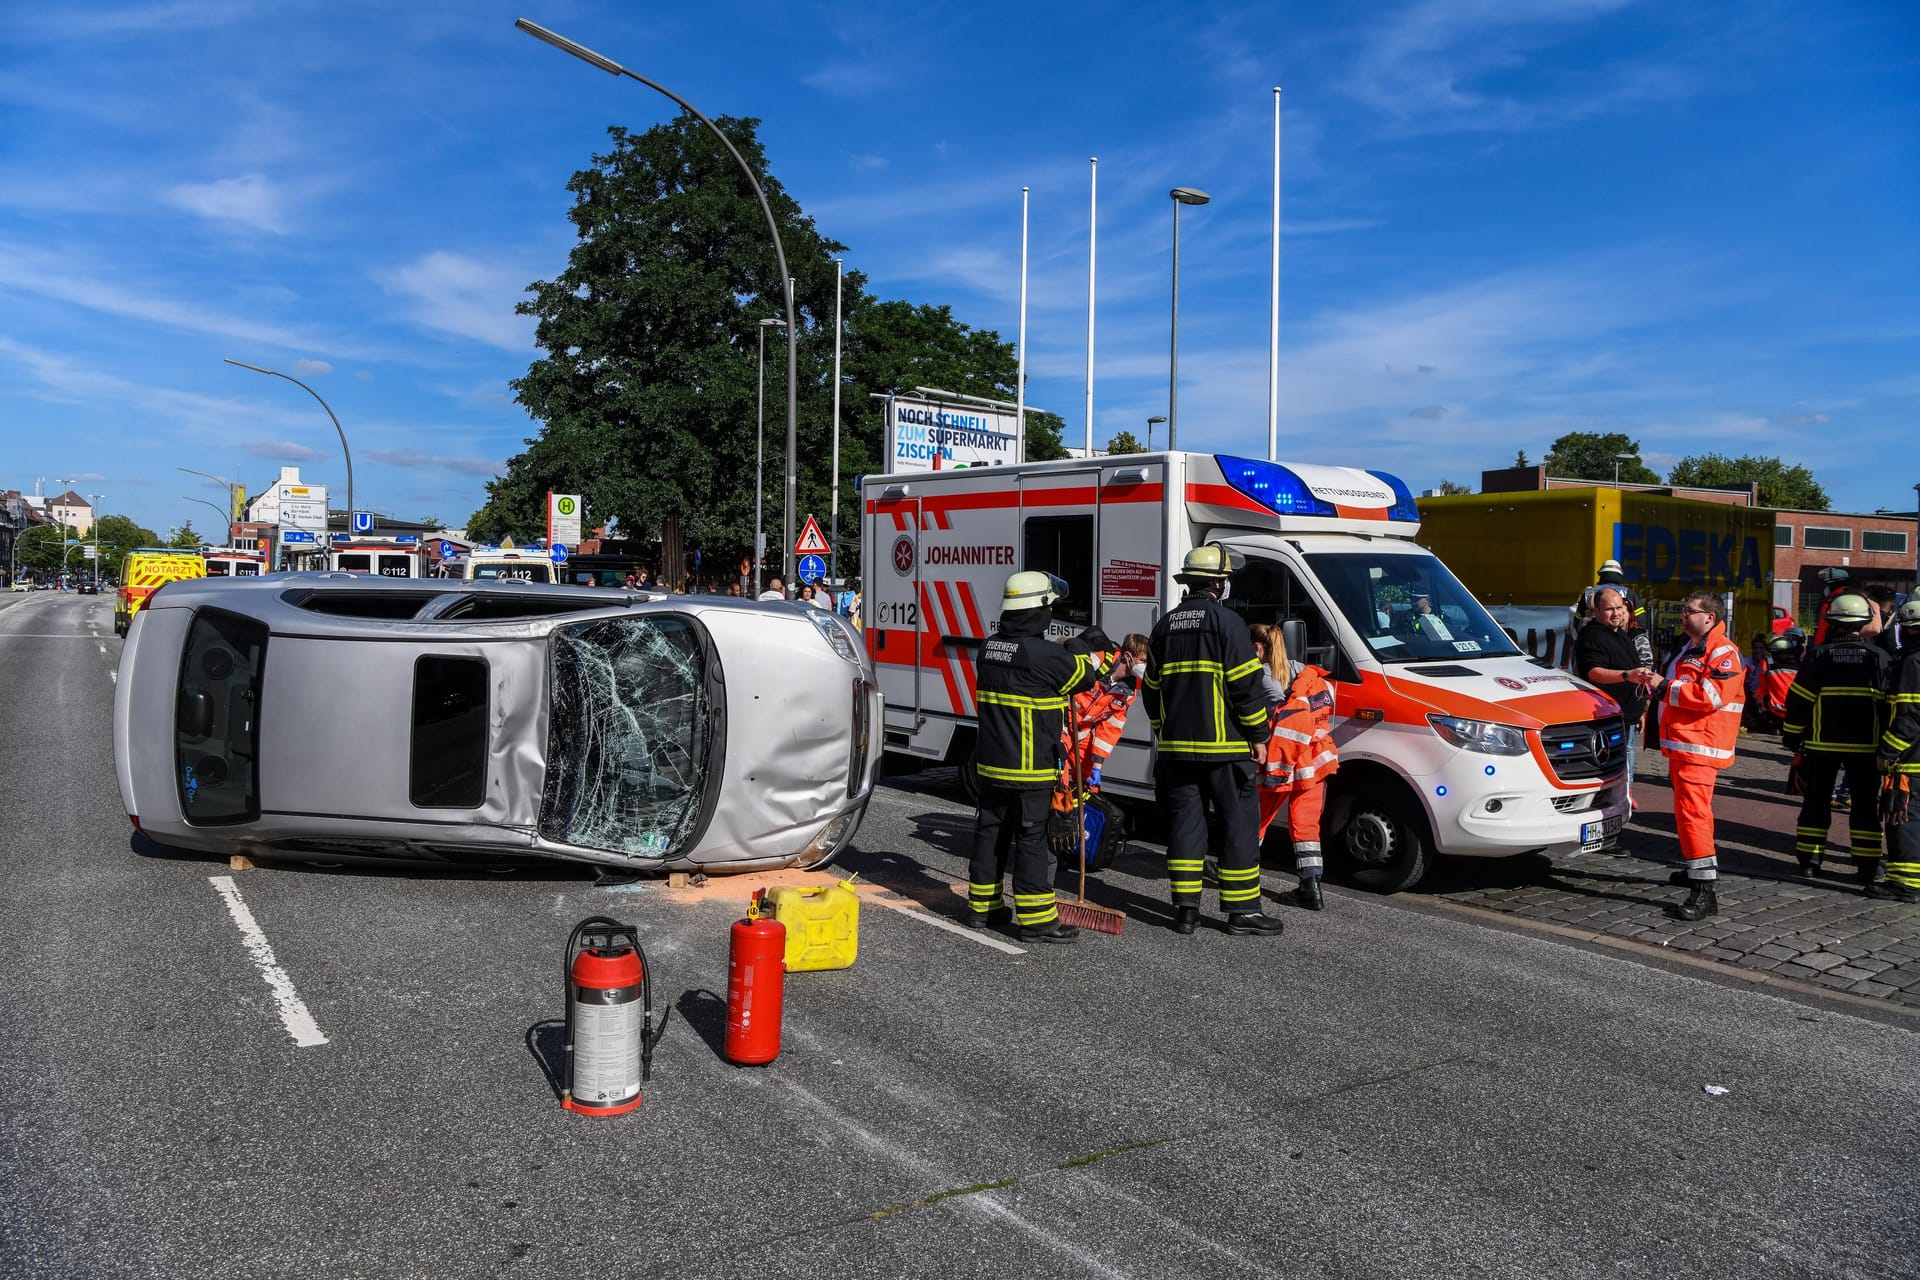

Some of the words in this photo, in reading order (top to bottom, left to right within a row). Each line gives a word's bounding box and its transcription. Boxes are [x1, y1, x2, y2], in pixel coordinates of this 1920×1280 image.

[898, 407, 932, 425] NOCH
[936, 412, 988, 432] SCHNELL
[897, 424, 925, 442] ZUM
[928, 428, 1009, 451] SUPERMARKT
[897, 442, 953, 460] ZISCHEN
[1311, 487, 1389, 499] RETTUNGSDIENST
[357, 514, 371, 530] U
[925, 545, 1015, 566] JOHANNITER
[1613, 521, 1762, 589] EDEKA
[144, 565, 192, 575] NOTARZT
[391, 567, 407, 576] 112
[513, 570, 532, 580] 112
[891, 602, 917, 625] 112
[1169, 619, 1201, 630] HAMBURG
[985, 640, 1019, 653] FEUERWEHR
[1829, 648, 1866, 656] FEUERWEHR
[985, 650, 1013, 662] HAMBURG
[1833, 656, 1863, 664] HAMBURG
[1587, 823, 1597, 840] HH
